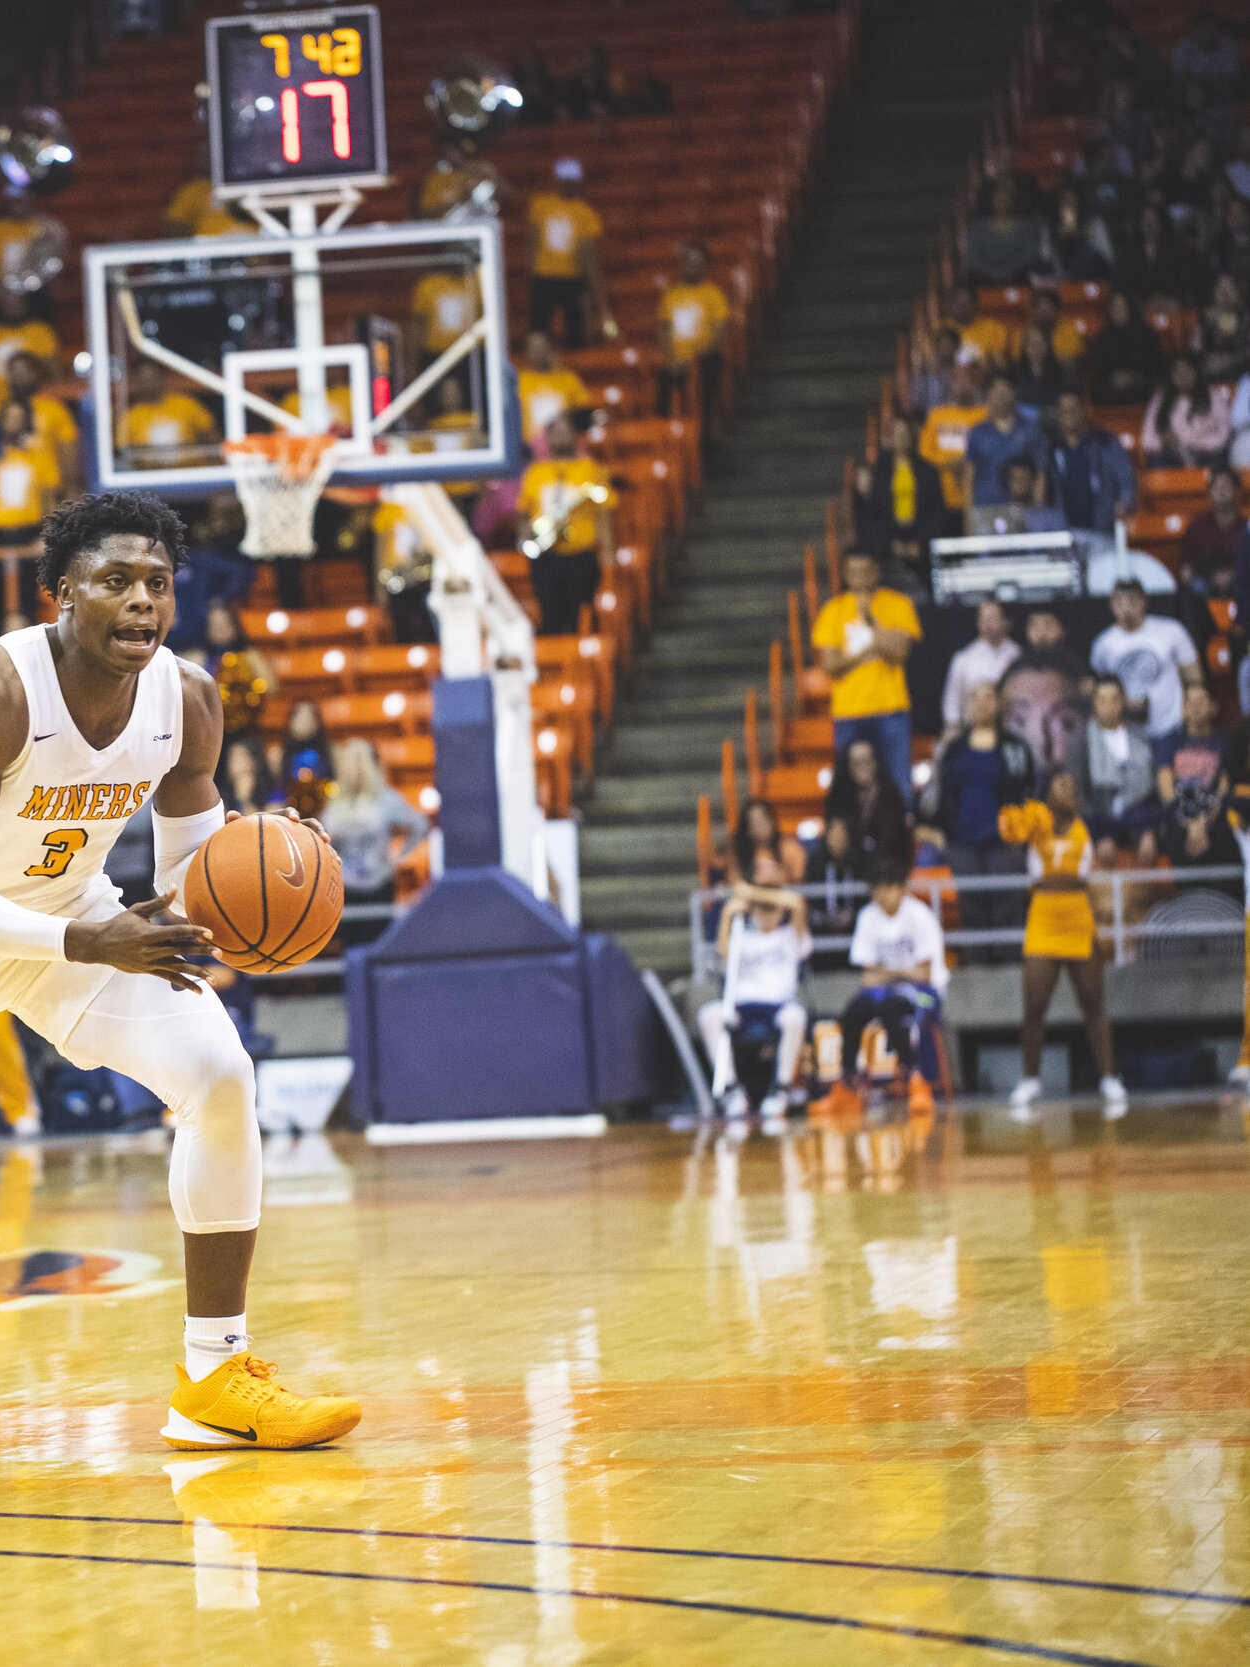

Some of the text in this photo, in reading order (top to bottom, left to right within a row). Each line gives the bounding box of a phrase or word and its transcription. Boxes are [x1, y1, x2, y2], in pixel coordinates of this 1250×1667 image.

[280, 79, 351, 164] 17
[17, 780, 151, 821] MINERS
[23, 828, 89, 879] 3
